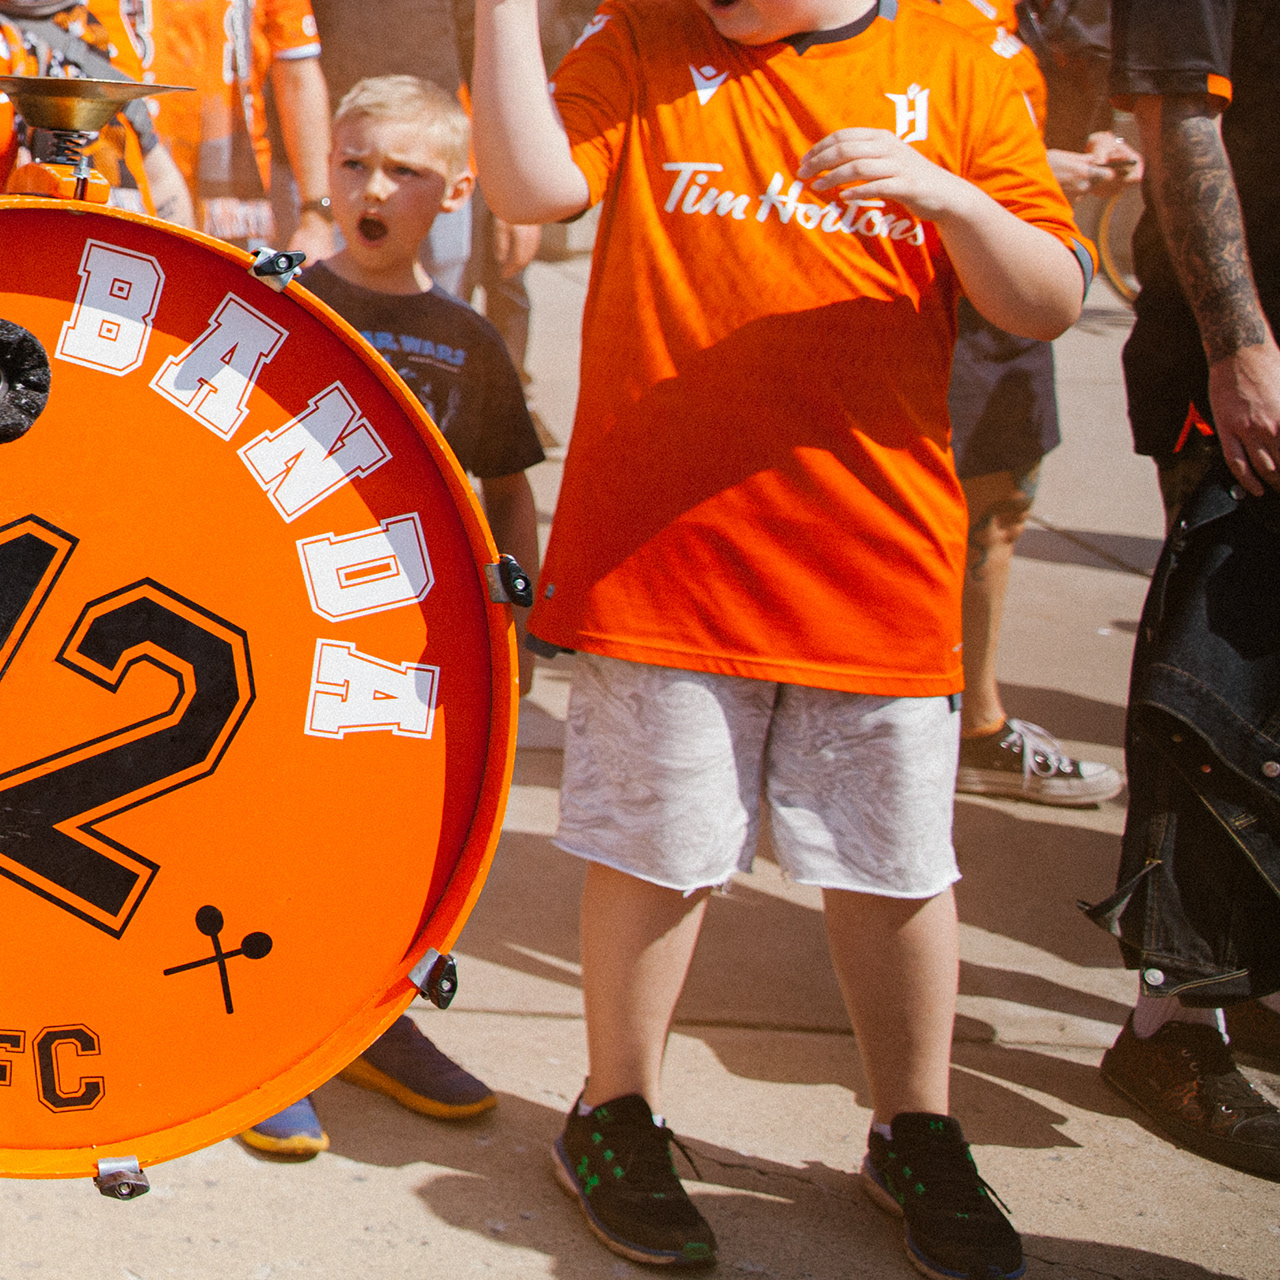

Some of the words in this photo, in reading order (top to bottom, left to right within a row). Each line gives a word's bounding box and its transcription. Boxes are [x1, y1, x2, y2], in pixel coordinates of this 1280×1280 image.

[662, 161, 751, 220] Tim
[756, 172, 926, 247] Hortons
[399, 333, 467, 366] WARS
[53, 237, 441, 741] BANDA
